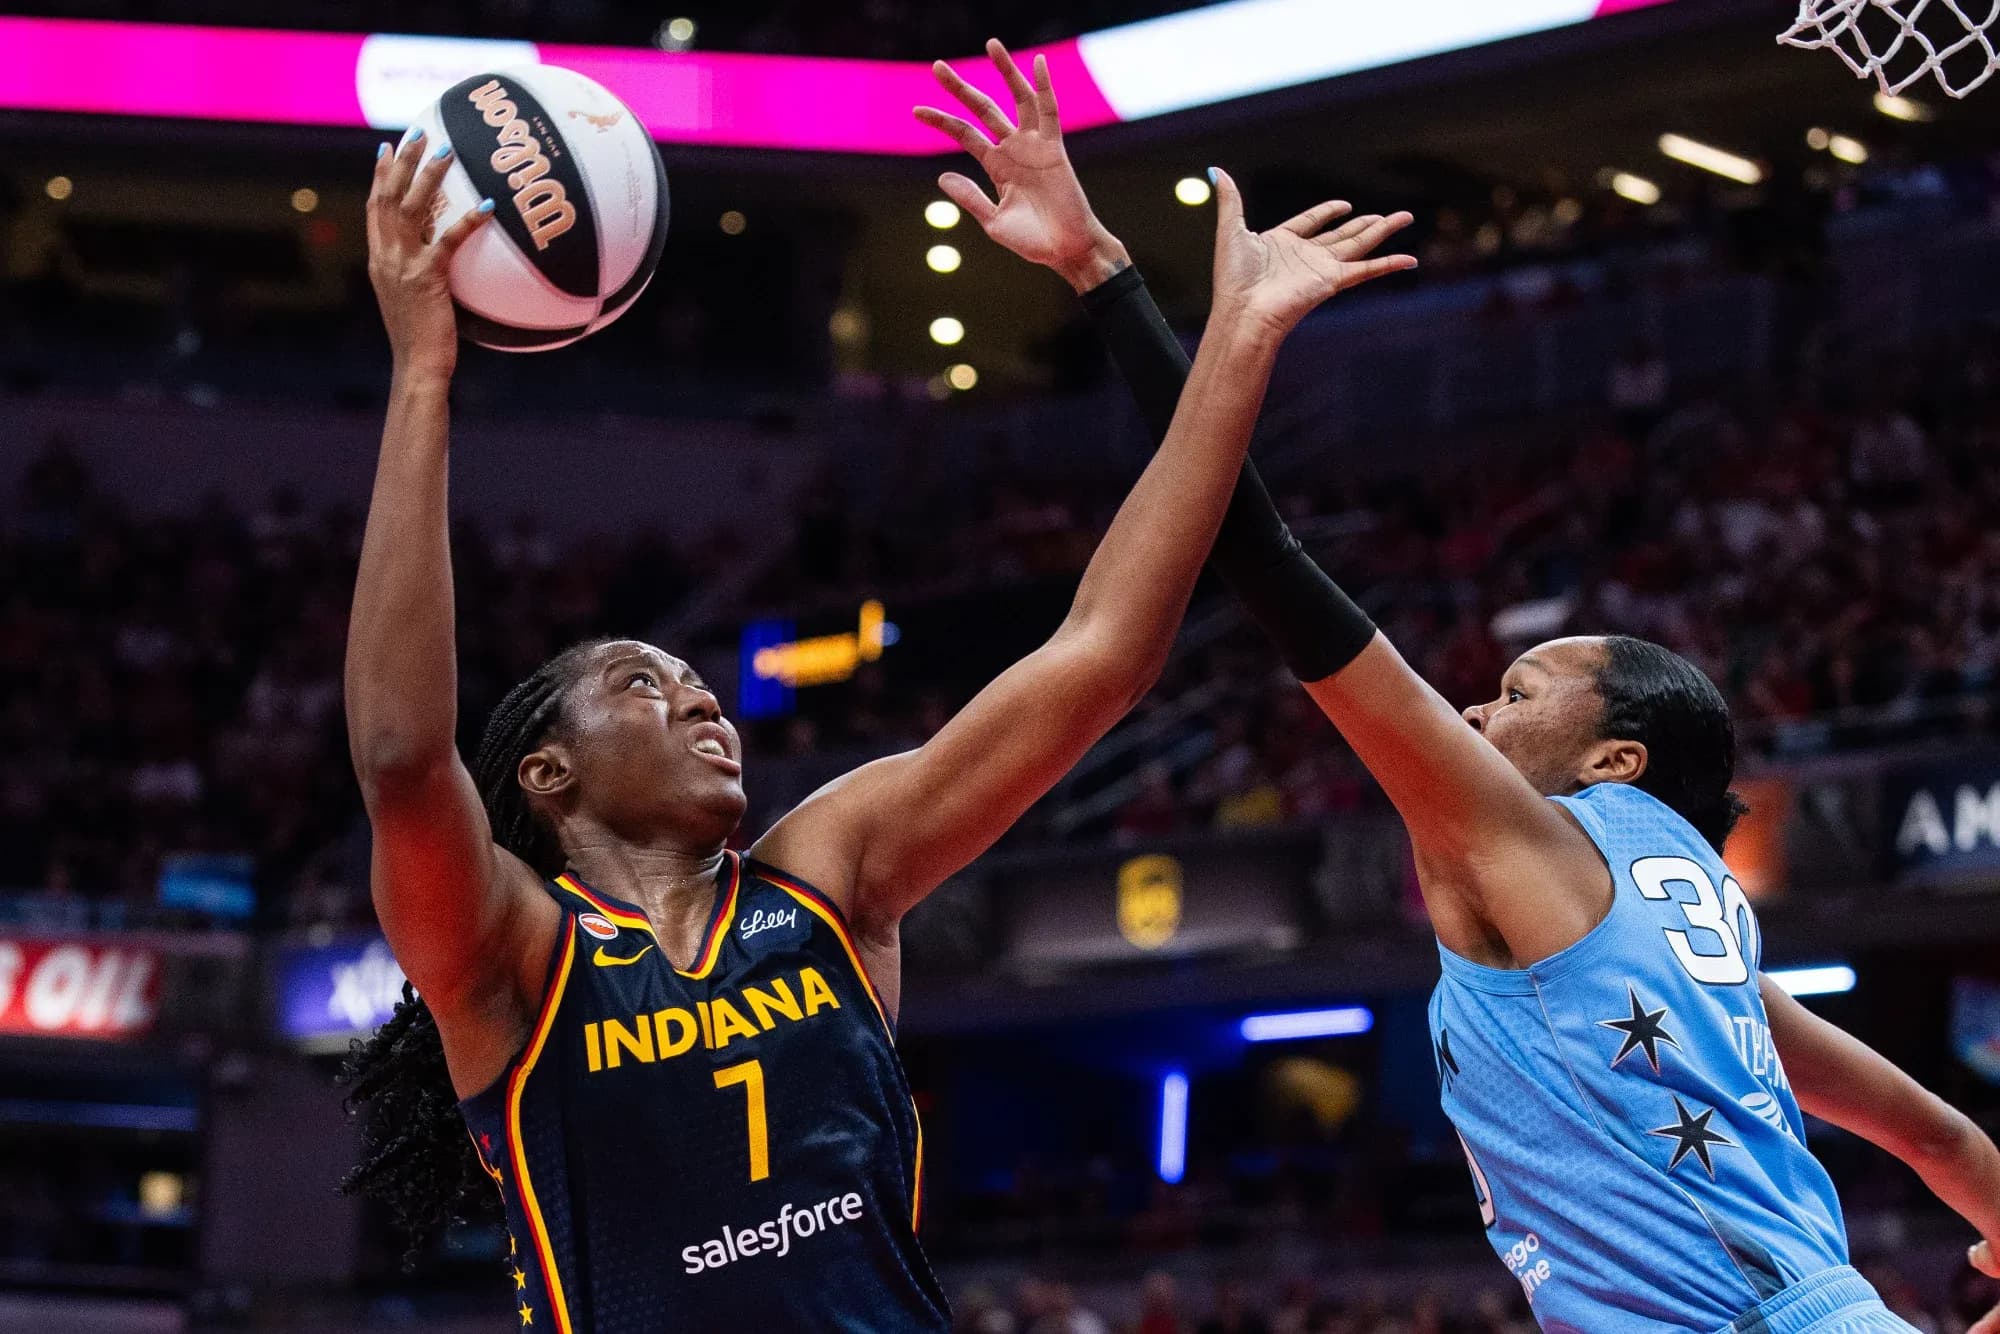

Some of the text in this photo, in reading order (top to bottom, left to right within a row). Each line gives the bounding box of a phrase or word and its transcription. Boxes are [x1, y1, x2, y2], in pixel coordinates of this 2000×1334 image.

[468, 79, 577, 251] Wilson
[740, 908, 797, 940] Lilly
[1629, 855, 1759, 986] 30
[584, 966, 841, 1073] INDIANA
[712, 1059, 770, 1185] 7
[681, 1192, 863, 1275] salesforce
